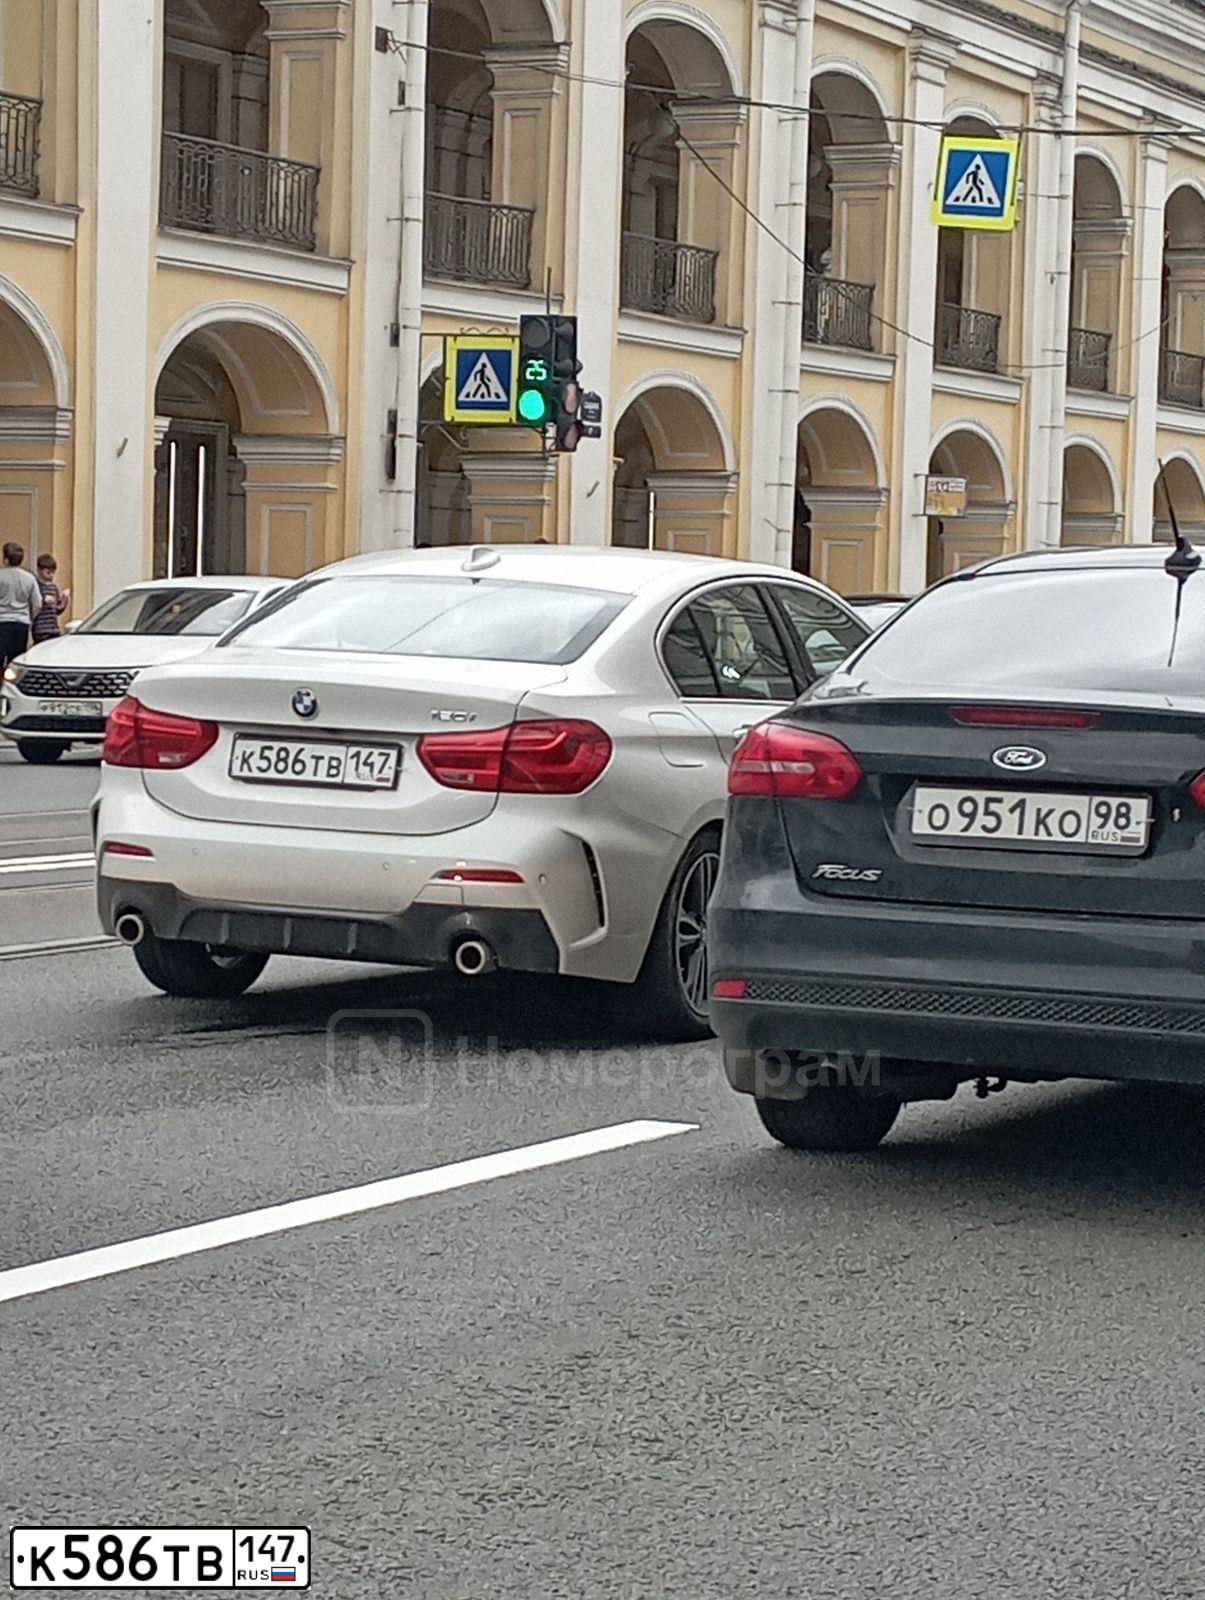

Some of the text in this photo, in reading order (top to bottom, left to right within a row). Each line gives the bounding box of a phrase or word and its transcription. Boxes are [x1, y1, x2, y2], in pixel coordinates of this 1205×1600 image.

[239, 745, 391, 778] К586ТВ 147
[927, 796, 1132, 838] О951КО 98
[1091, 830, 1119, 842] RUS
